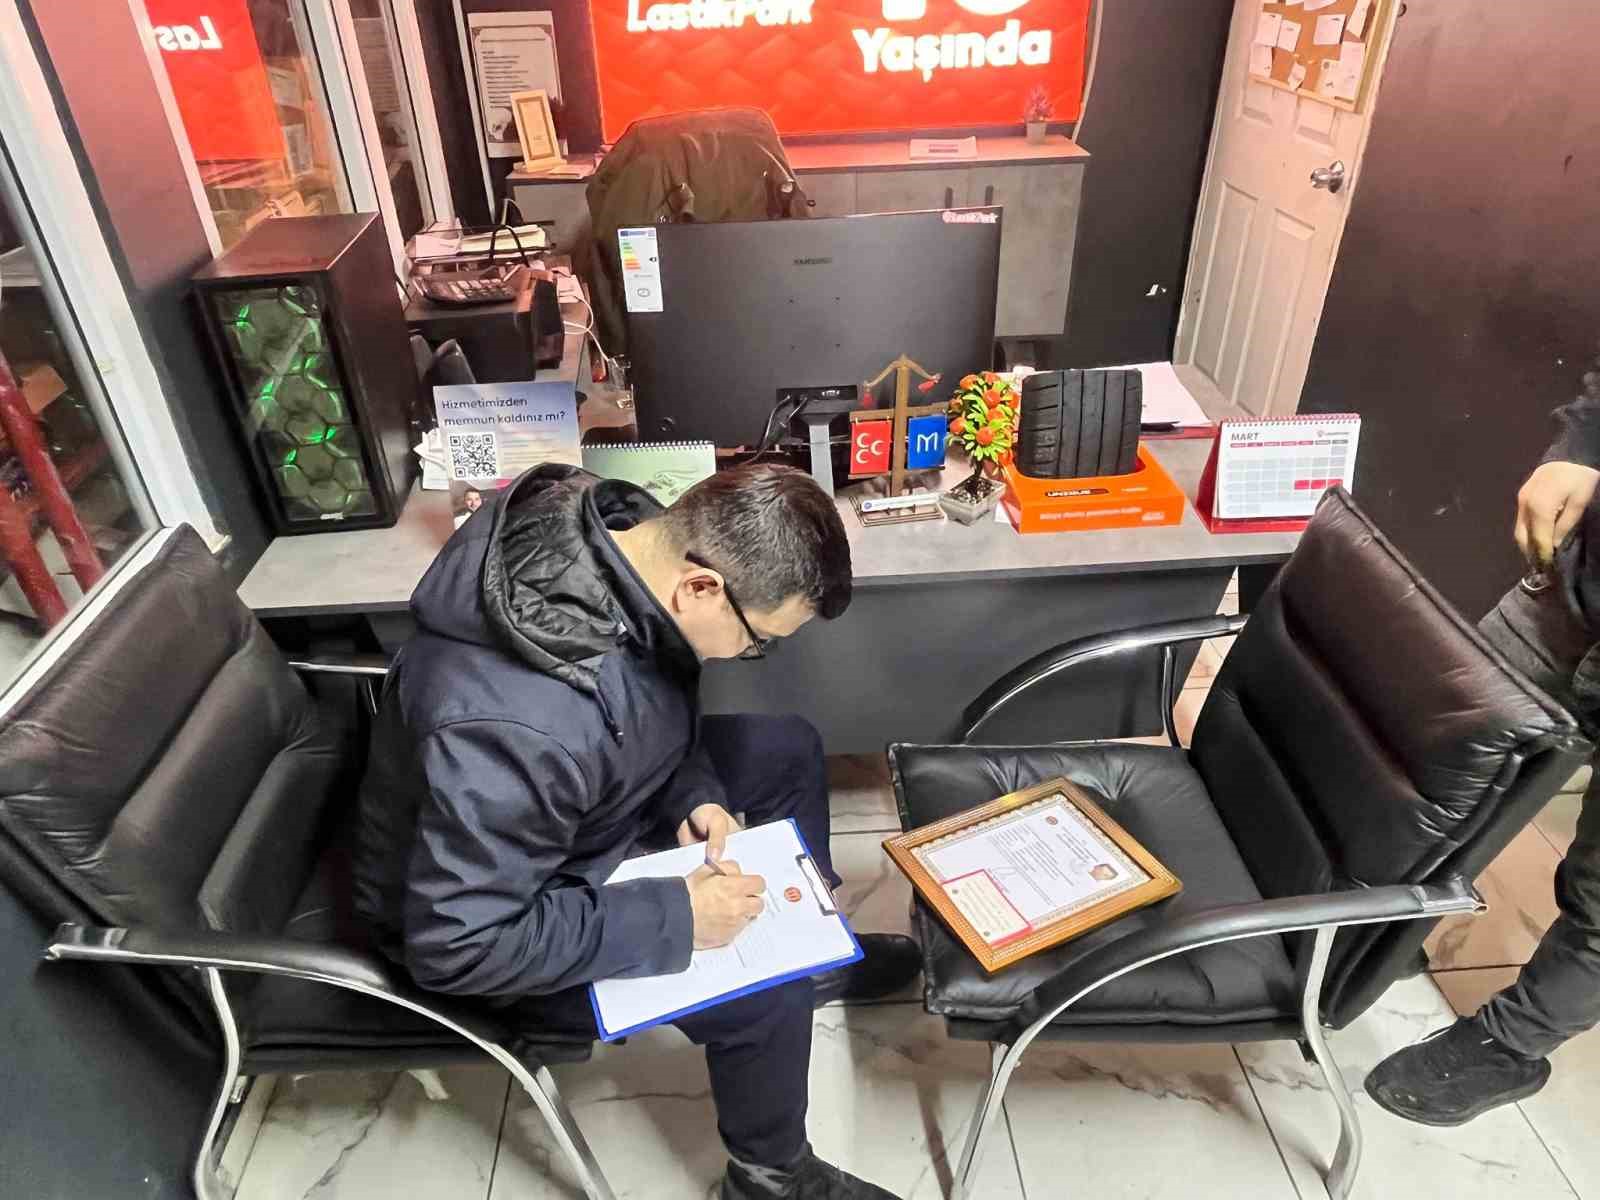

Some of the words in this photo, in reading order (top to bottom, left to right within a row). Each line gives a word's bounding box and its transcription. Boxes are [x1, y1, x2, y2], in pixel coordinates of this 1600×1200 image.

[851, 18, 1052, 84] Yaşında
[441, 397, 528, 409] Hizmetimizden
[444, 416, 496, 426] memnun
[1231, 431, 1260, 441] MART
